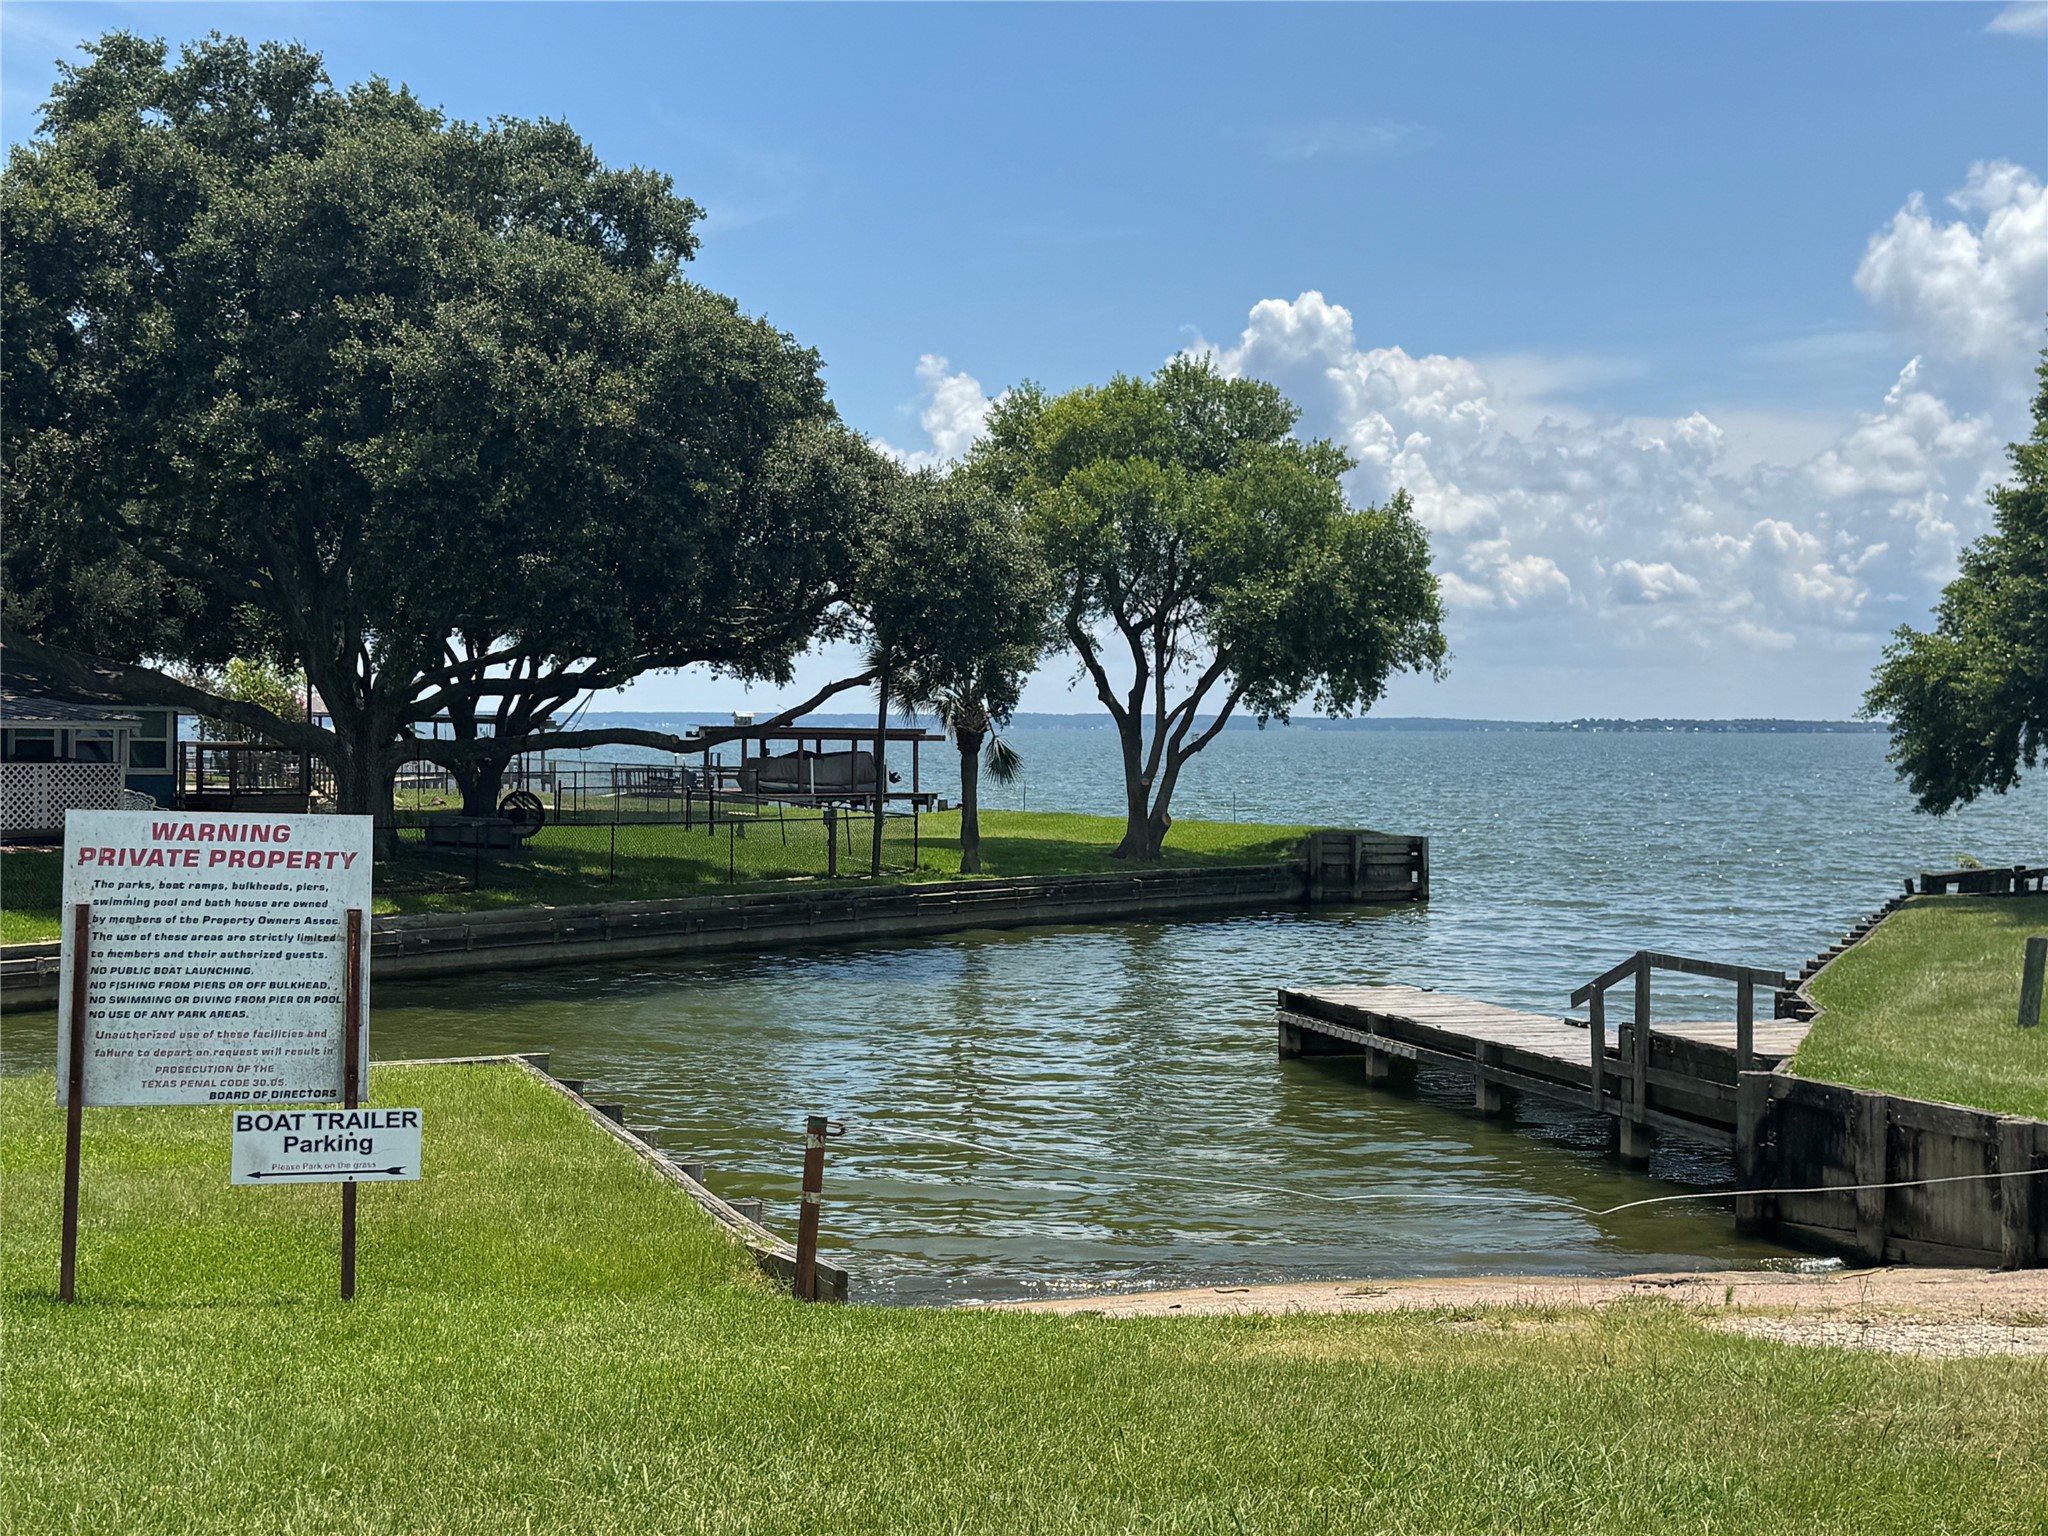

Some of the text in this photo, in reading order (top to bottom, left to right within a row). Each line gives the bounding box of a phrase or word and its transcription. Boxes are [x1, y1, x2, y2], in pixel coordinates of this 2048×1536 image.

[152, 822, 291, 843] WARNING
[78, 847, 358, 870] PRIVATE PROPERTY
[94, 879, 328, 893] The parks, boat ramps, bulkheads, piers,
[93, 897, 328, 908] swimming pool and bath house are owned
[92, 914, 106, 925] by
[109, 915, 161, 924] members
[165, 915, 176, 924] of
[180, 915, 199, 924] the
[202, 915, 255, 926] Property
[258, 916, 300, 925] Owners
[92, 931, 336, 943] The use of these areas are strictly limited
[91, 949, 327, 960] to members and their authorized guests.
[90, 966, 107, 975] NO
[110, 966, 150, 975] PUBLIC
[154, 966, 182, 975] BOAT
[90, 981, 106, 989] NO
[110, 981, 155, 990] FISHING
[159, 981, 190, 989] FROM
[193, 981, 225, 989] PIERS
[229, 981, 243, 989] OR
[246, 981, 266, 989] OFF
[89, 996, 106, 1004] NO
[109, 996, 171, 1004] SWIMMING
[175, 996, 189, 1004] OR
[193, 996, 231, 1004] DIVING
[235, 996, 266, 1004] FROM
[269, 996, 293, 1004] PIER
[297, 996, 311, 1004] OR
[89, 1010, 249, 1019] NO USE OF ANY PARK AREAS.
[95, 1029, 327, 1040] Unauthorized use of these facilities and
[95, 1047, 333, 1059] failure to depart on request will result in
[155, 1064, 274, 1074] PROSECUTION OF THE
[142, 1080, 177, 1088] TEXAS
[180, 1079, 216, 1088] PENAL
[220, 1079, 249, 1087] CODE
[209, 1089, 336, 1100] BOARD OF DIRECTORS
[237, 1111, 418, 1132] BOAT TRAILER
[284, 1134, 373, 1155] Parking
[272, 1163, 300, 1171] Please
[303, 1162, 321, 1170] Park
[338, 1161, 351, 1169] the
[353, 1162, 376, 1170] grass
